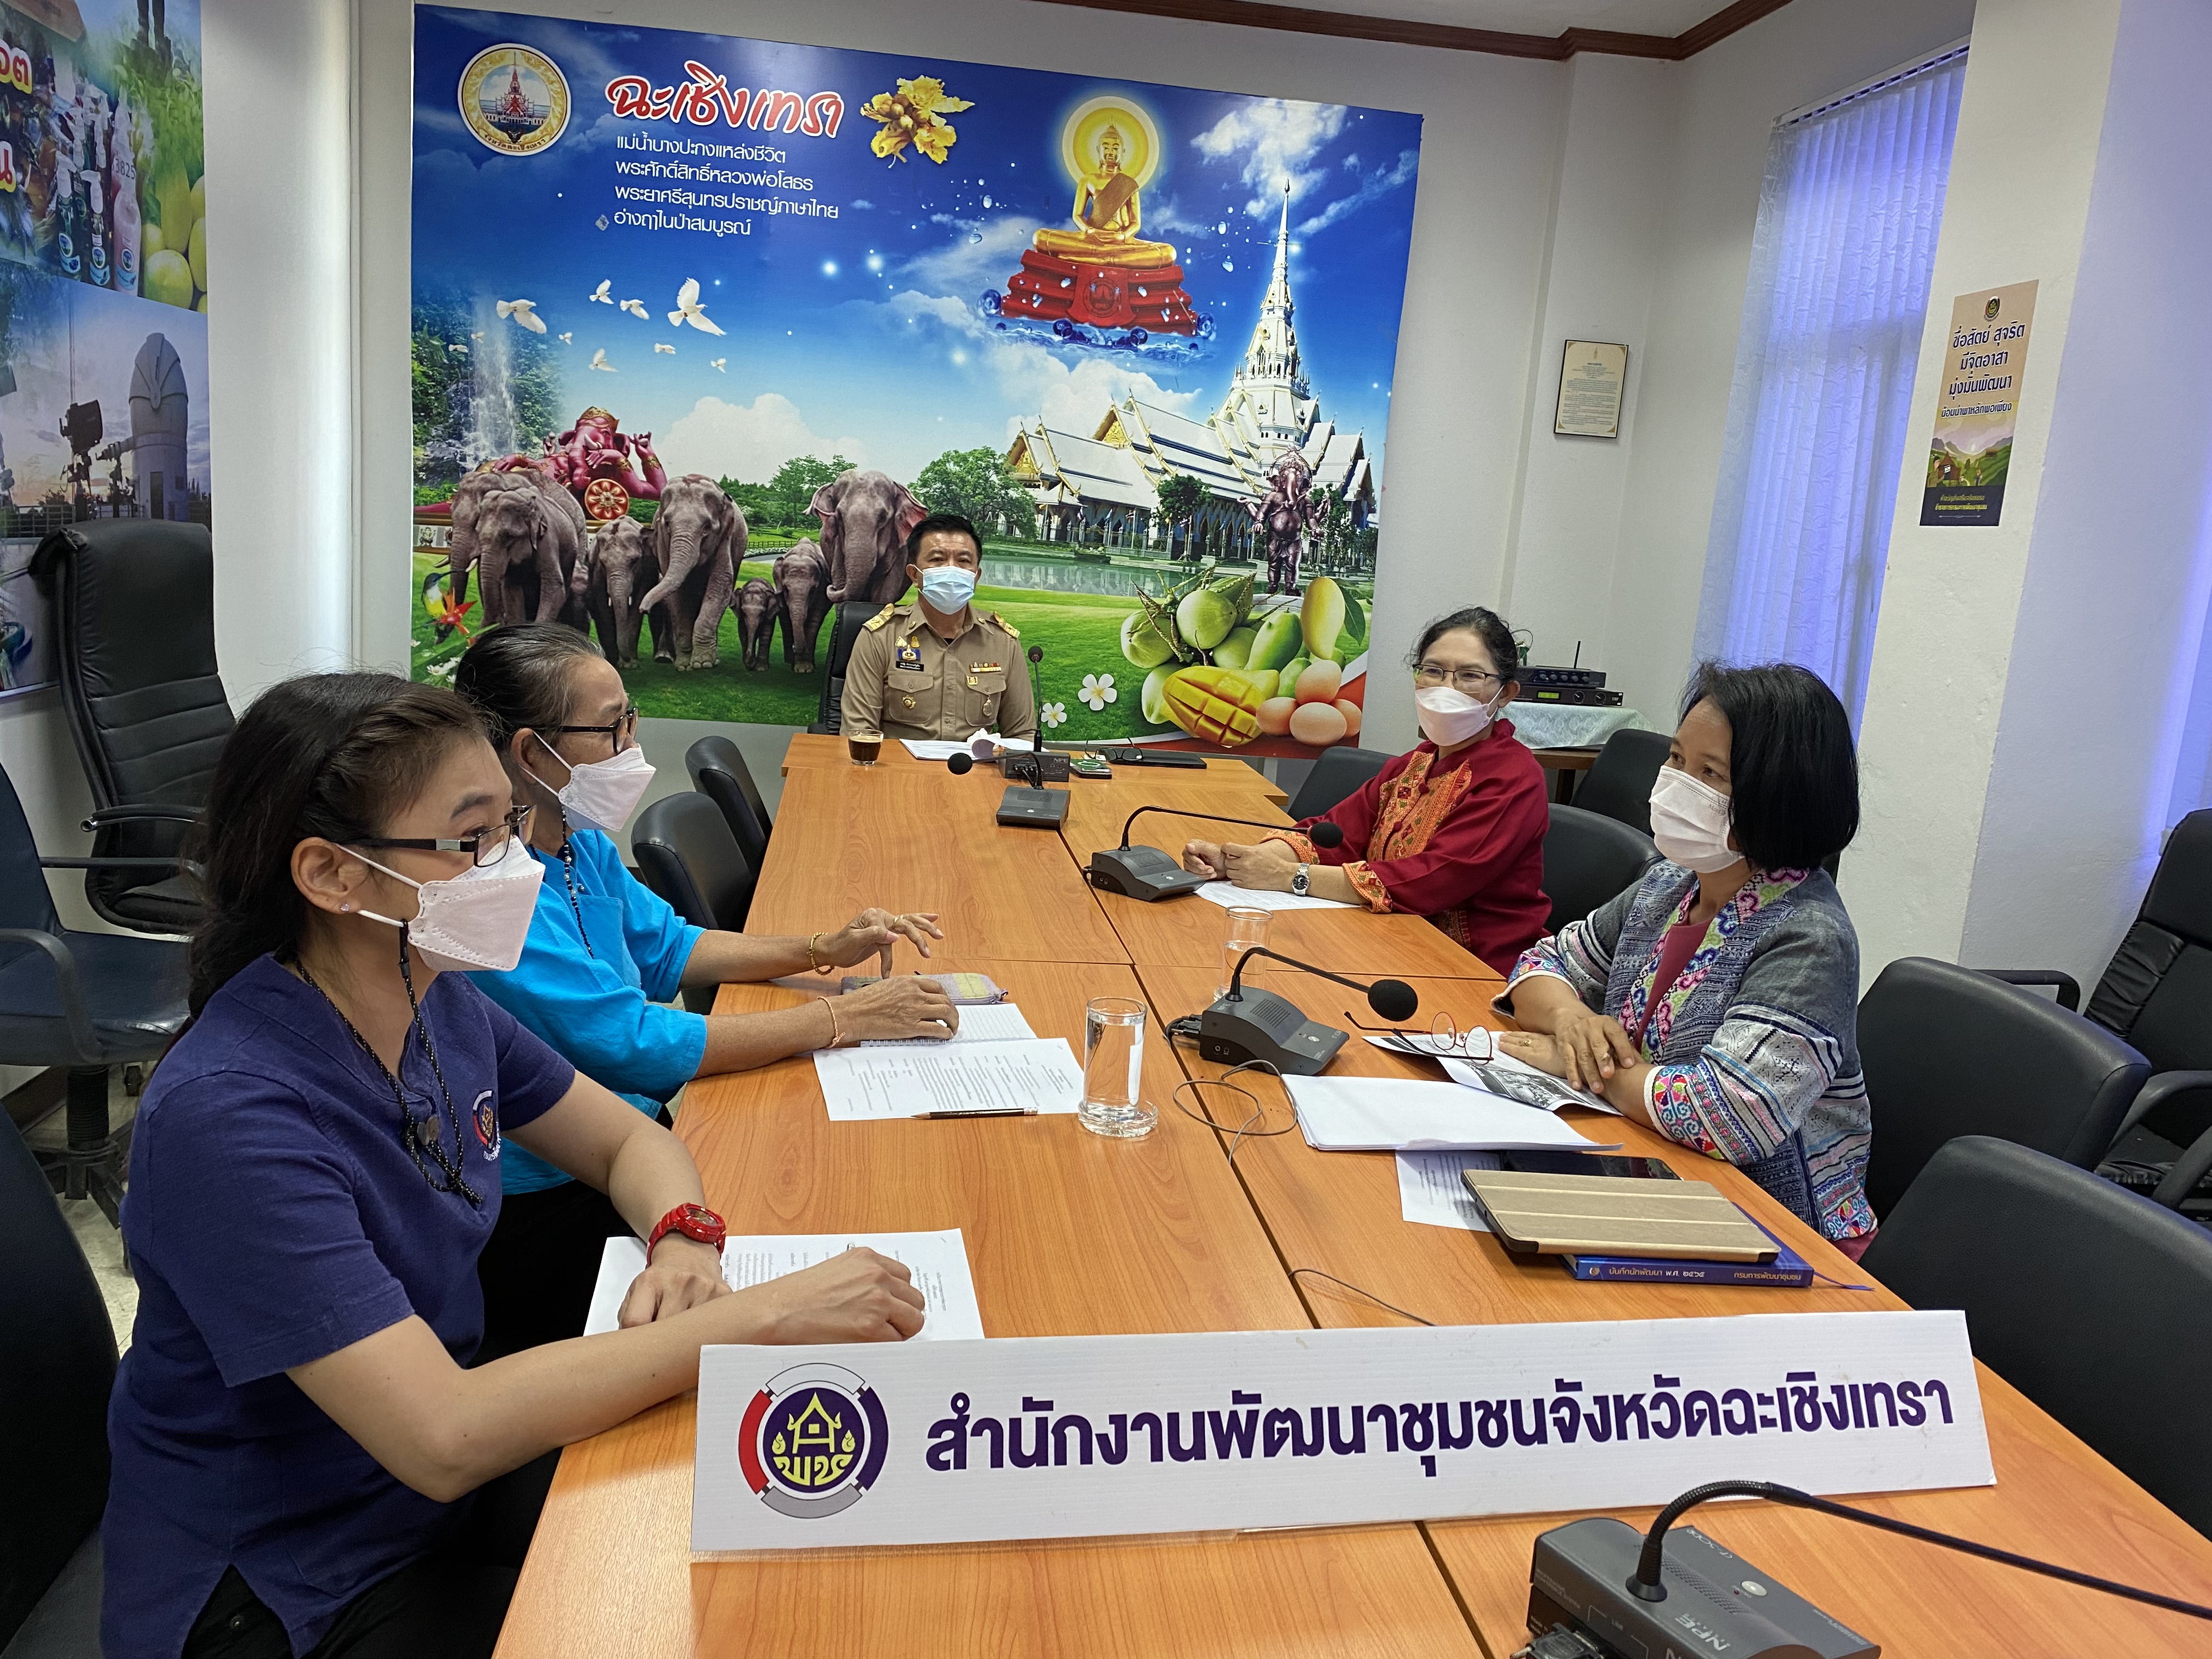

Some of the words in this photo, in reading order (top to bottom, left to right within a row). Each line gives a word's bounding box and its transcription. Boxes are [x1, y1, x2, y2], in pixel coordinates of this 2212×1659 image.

[605, 60, 844, 138] ฉะเชิงเทรา
[617, 131, 786, 163] แม่น้ำบางปะกงแหล่งชีวิต
[615, 160, 814, 191] พระศักดิ์สิทธิ์หลวงพ่อโสธร
[614, 186, 839, 219] พระยาศรีสุนทรปราชญ์ภาษาไทย
[1993, 321, 2025, 347] สุจริต
[1960, 350, 2009, 370] มีจิตอาสา
[1949, 370, 2012, 400] มุ่งมั่นพัฒนา
[1609, 1266, 1663, 1277] บันทึกนักพัฒนา
[1734, 1271, 1802, 1281] กรมการพัฒนาชุมชน
[926, 1371, 1954, 1477] สำนักงานพัฒนาชุมชนจังหวัดฉะเชิงเทรา
[1675, 1615, 1729, 1651] NPE
